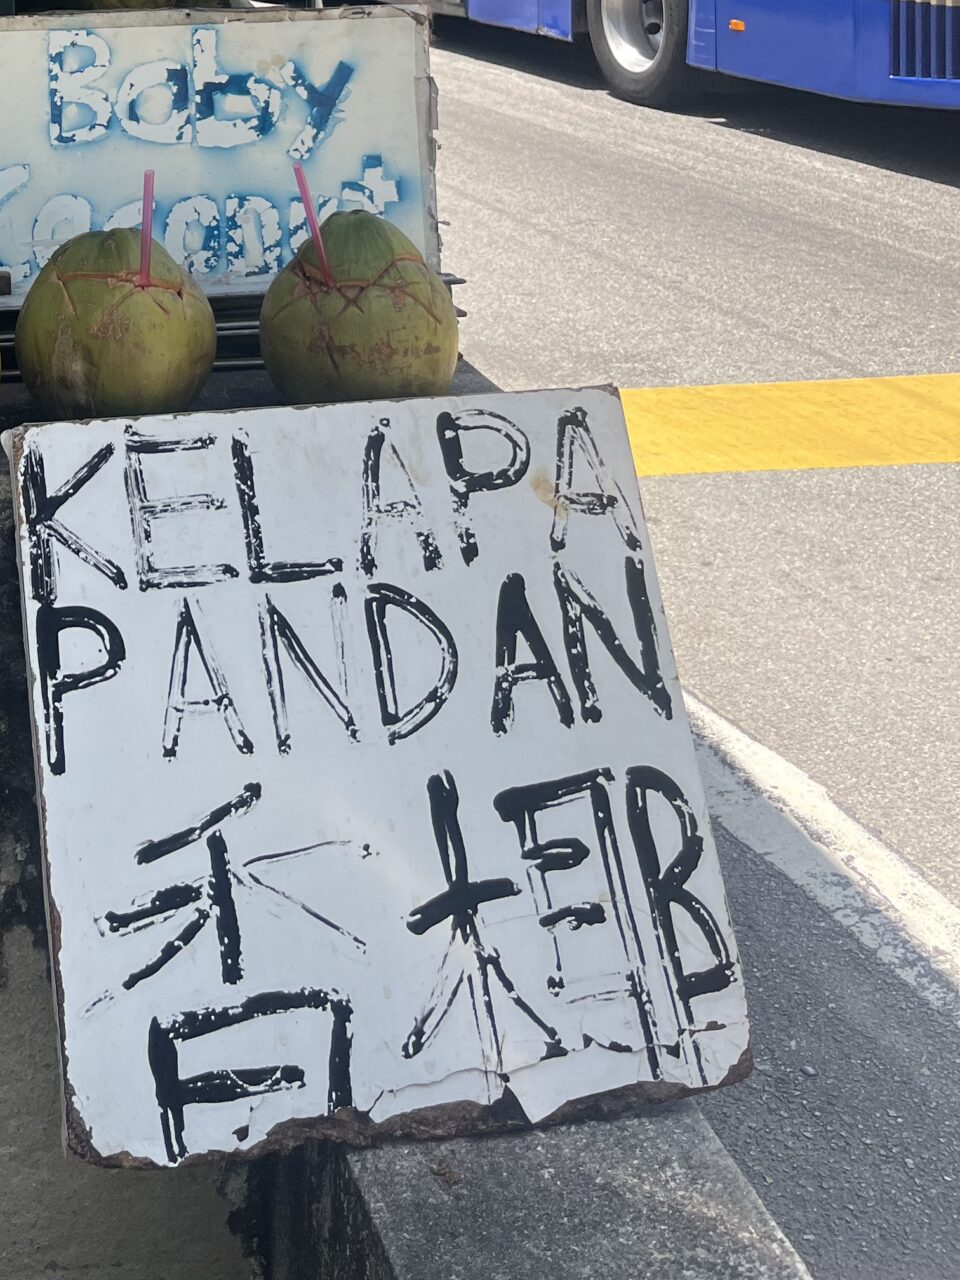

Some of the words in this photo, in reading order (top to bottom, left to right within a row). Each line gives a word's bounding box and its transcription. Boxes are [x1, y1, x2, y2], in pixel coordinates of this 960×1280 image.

[48, 28, 355, 161] Baby
[20, 407, 642, 604] KELAPA
[37, 556, 674, 775] PANDAN
